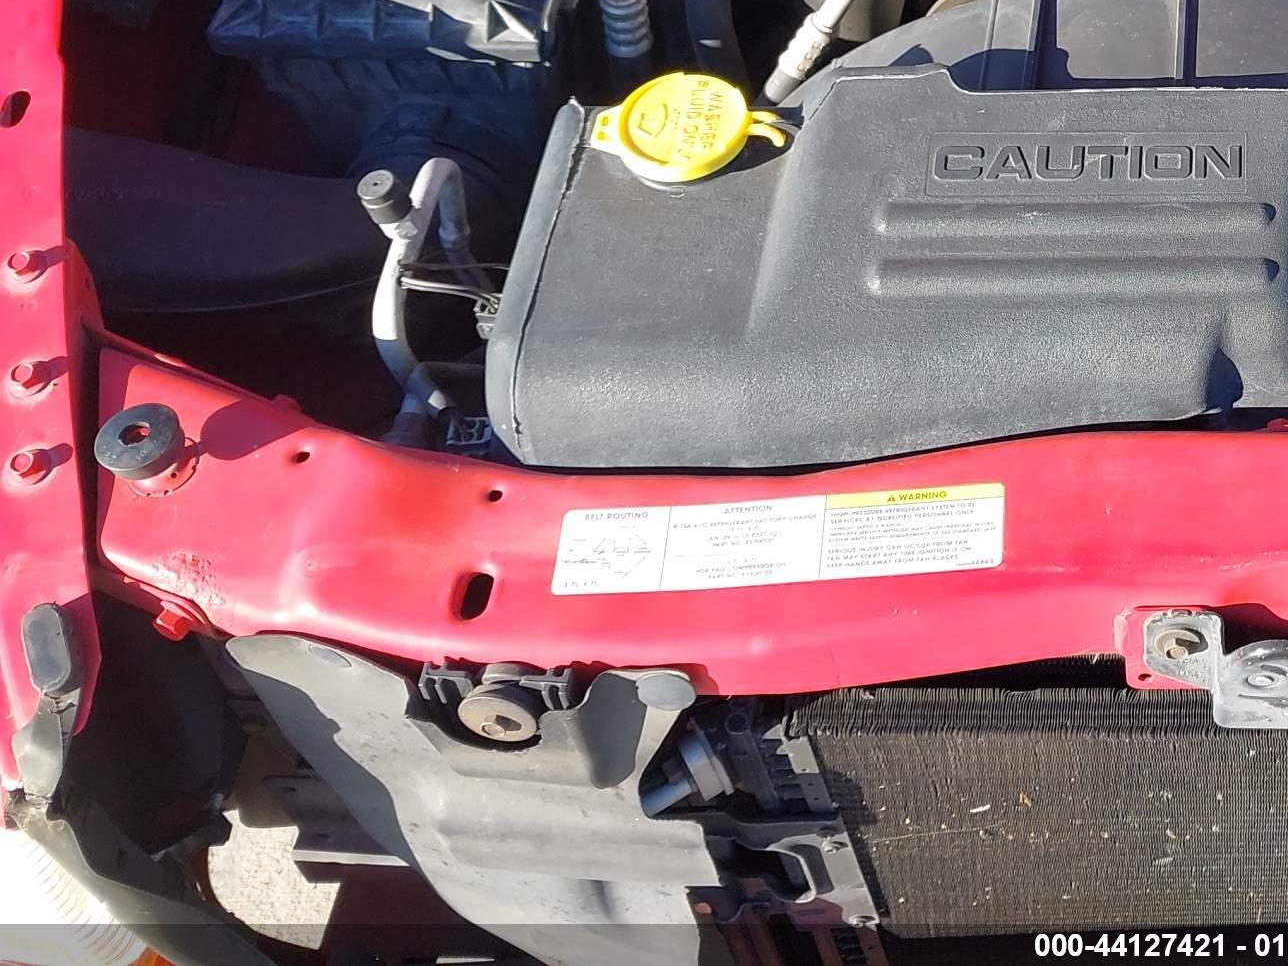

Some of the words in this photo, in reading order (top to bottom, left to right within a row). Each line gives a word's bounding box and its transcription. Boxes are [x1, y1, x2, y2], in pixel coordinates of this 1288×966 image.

[932, 144, 1246, 181] CAUTION
[898, 490, 948, 501] WARNING
[723, 505, 773, 514] ATTENTION
